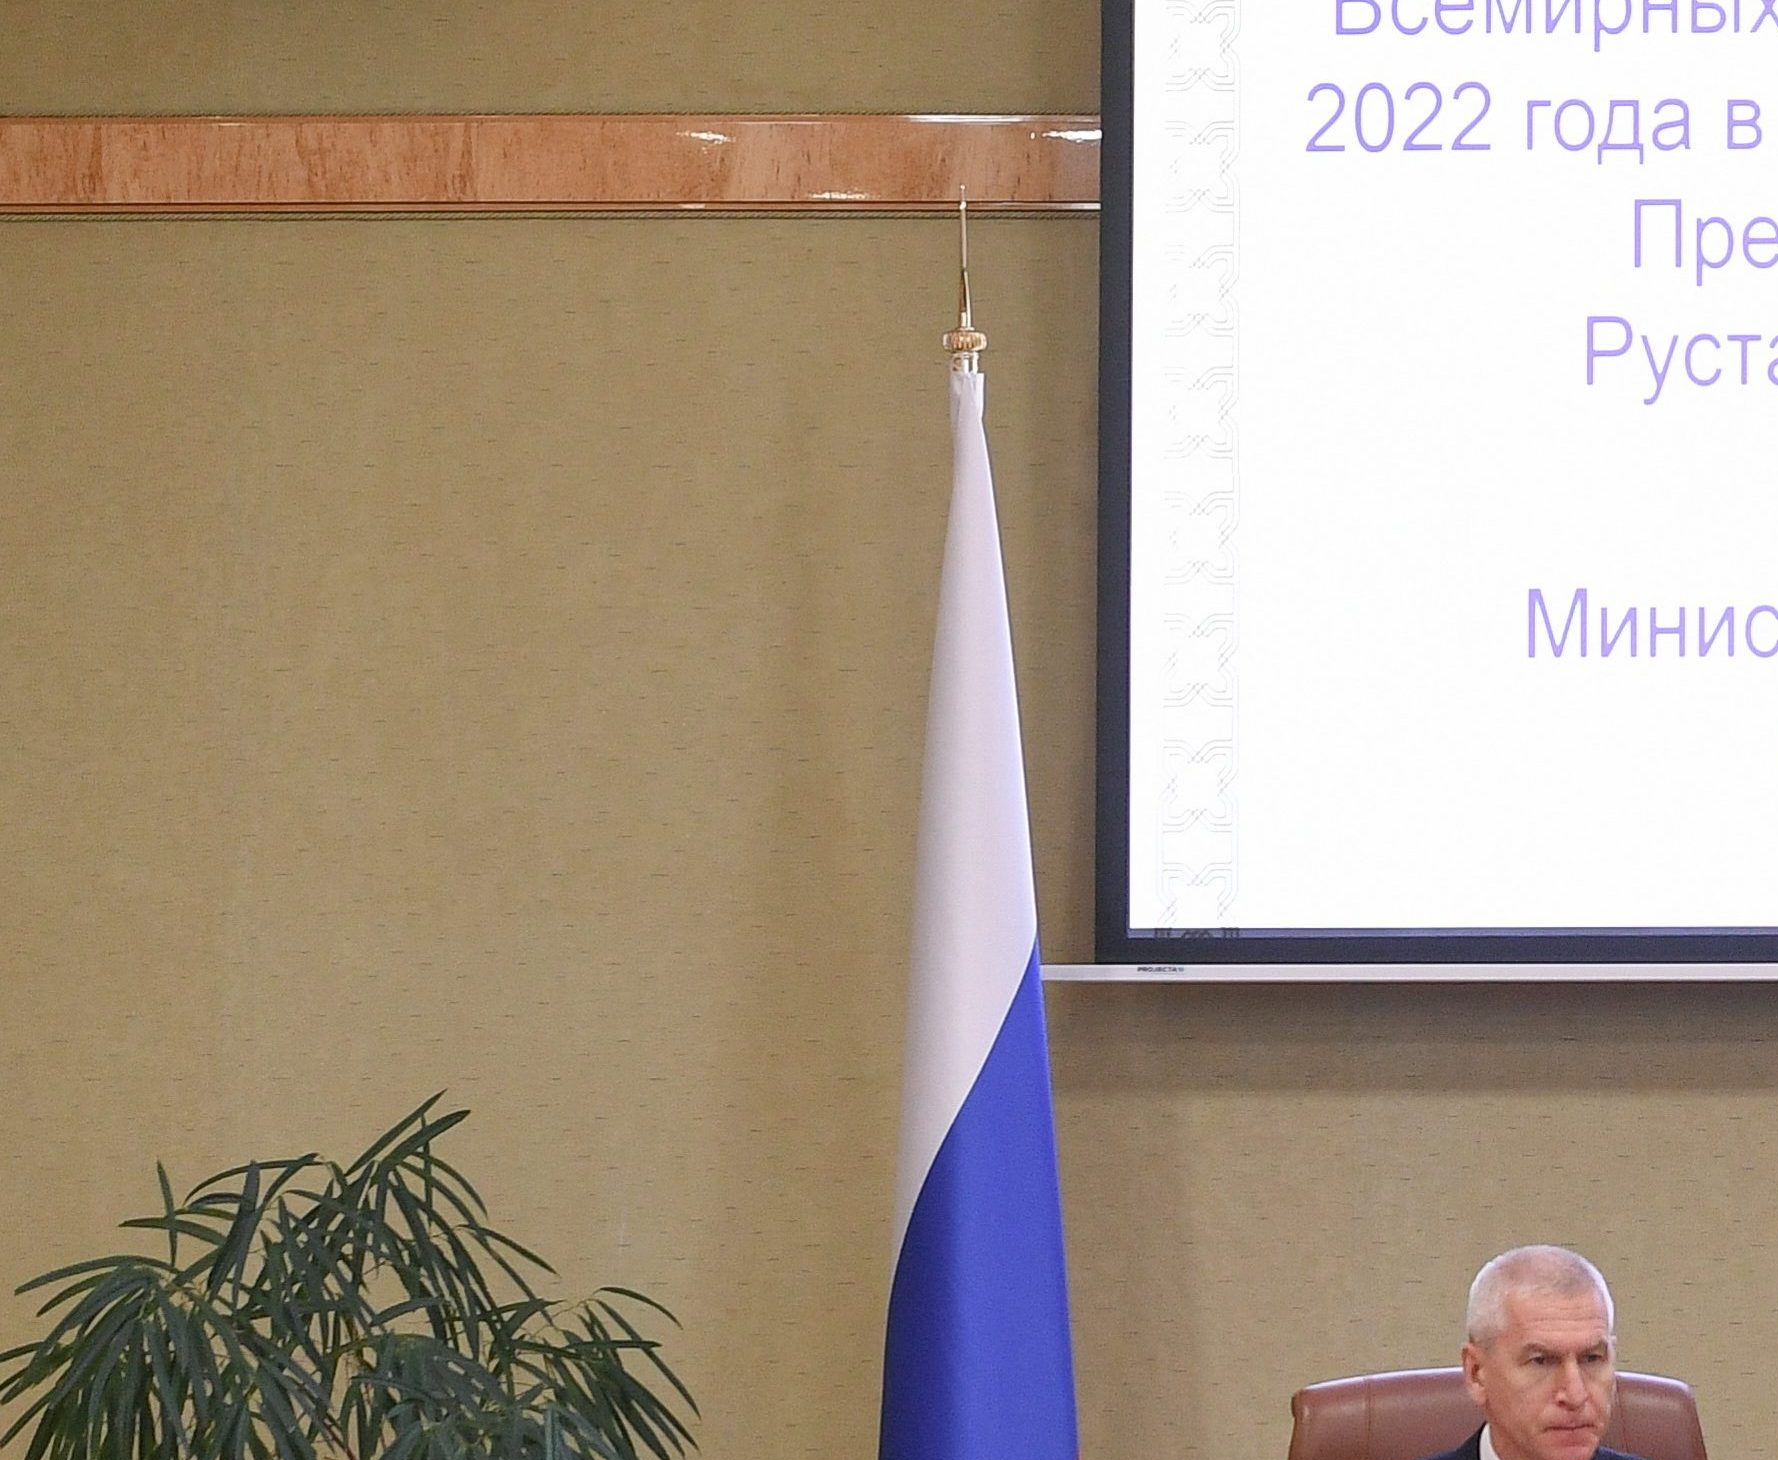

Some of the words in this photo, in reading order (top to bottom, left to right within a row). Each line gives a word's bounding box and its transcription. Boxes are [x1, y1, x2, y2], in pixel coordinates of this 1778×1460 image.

[1305, 81, 1491, 153] 2022
[1527, 98, 1691, 165] года
[1727, 99, 1762, 149] в
